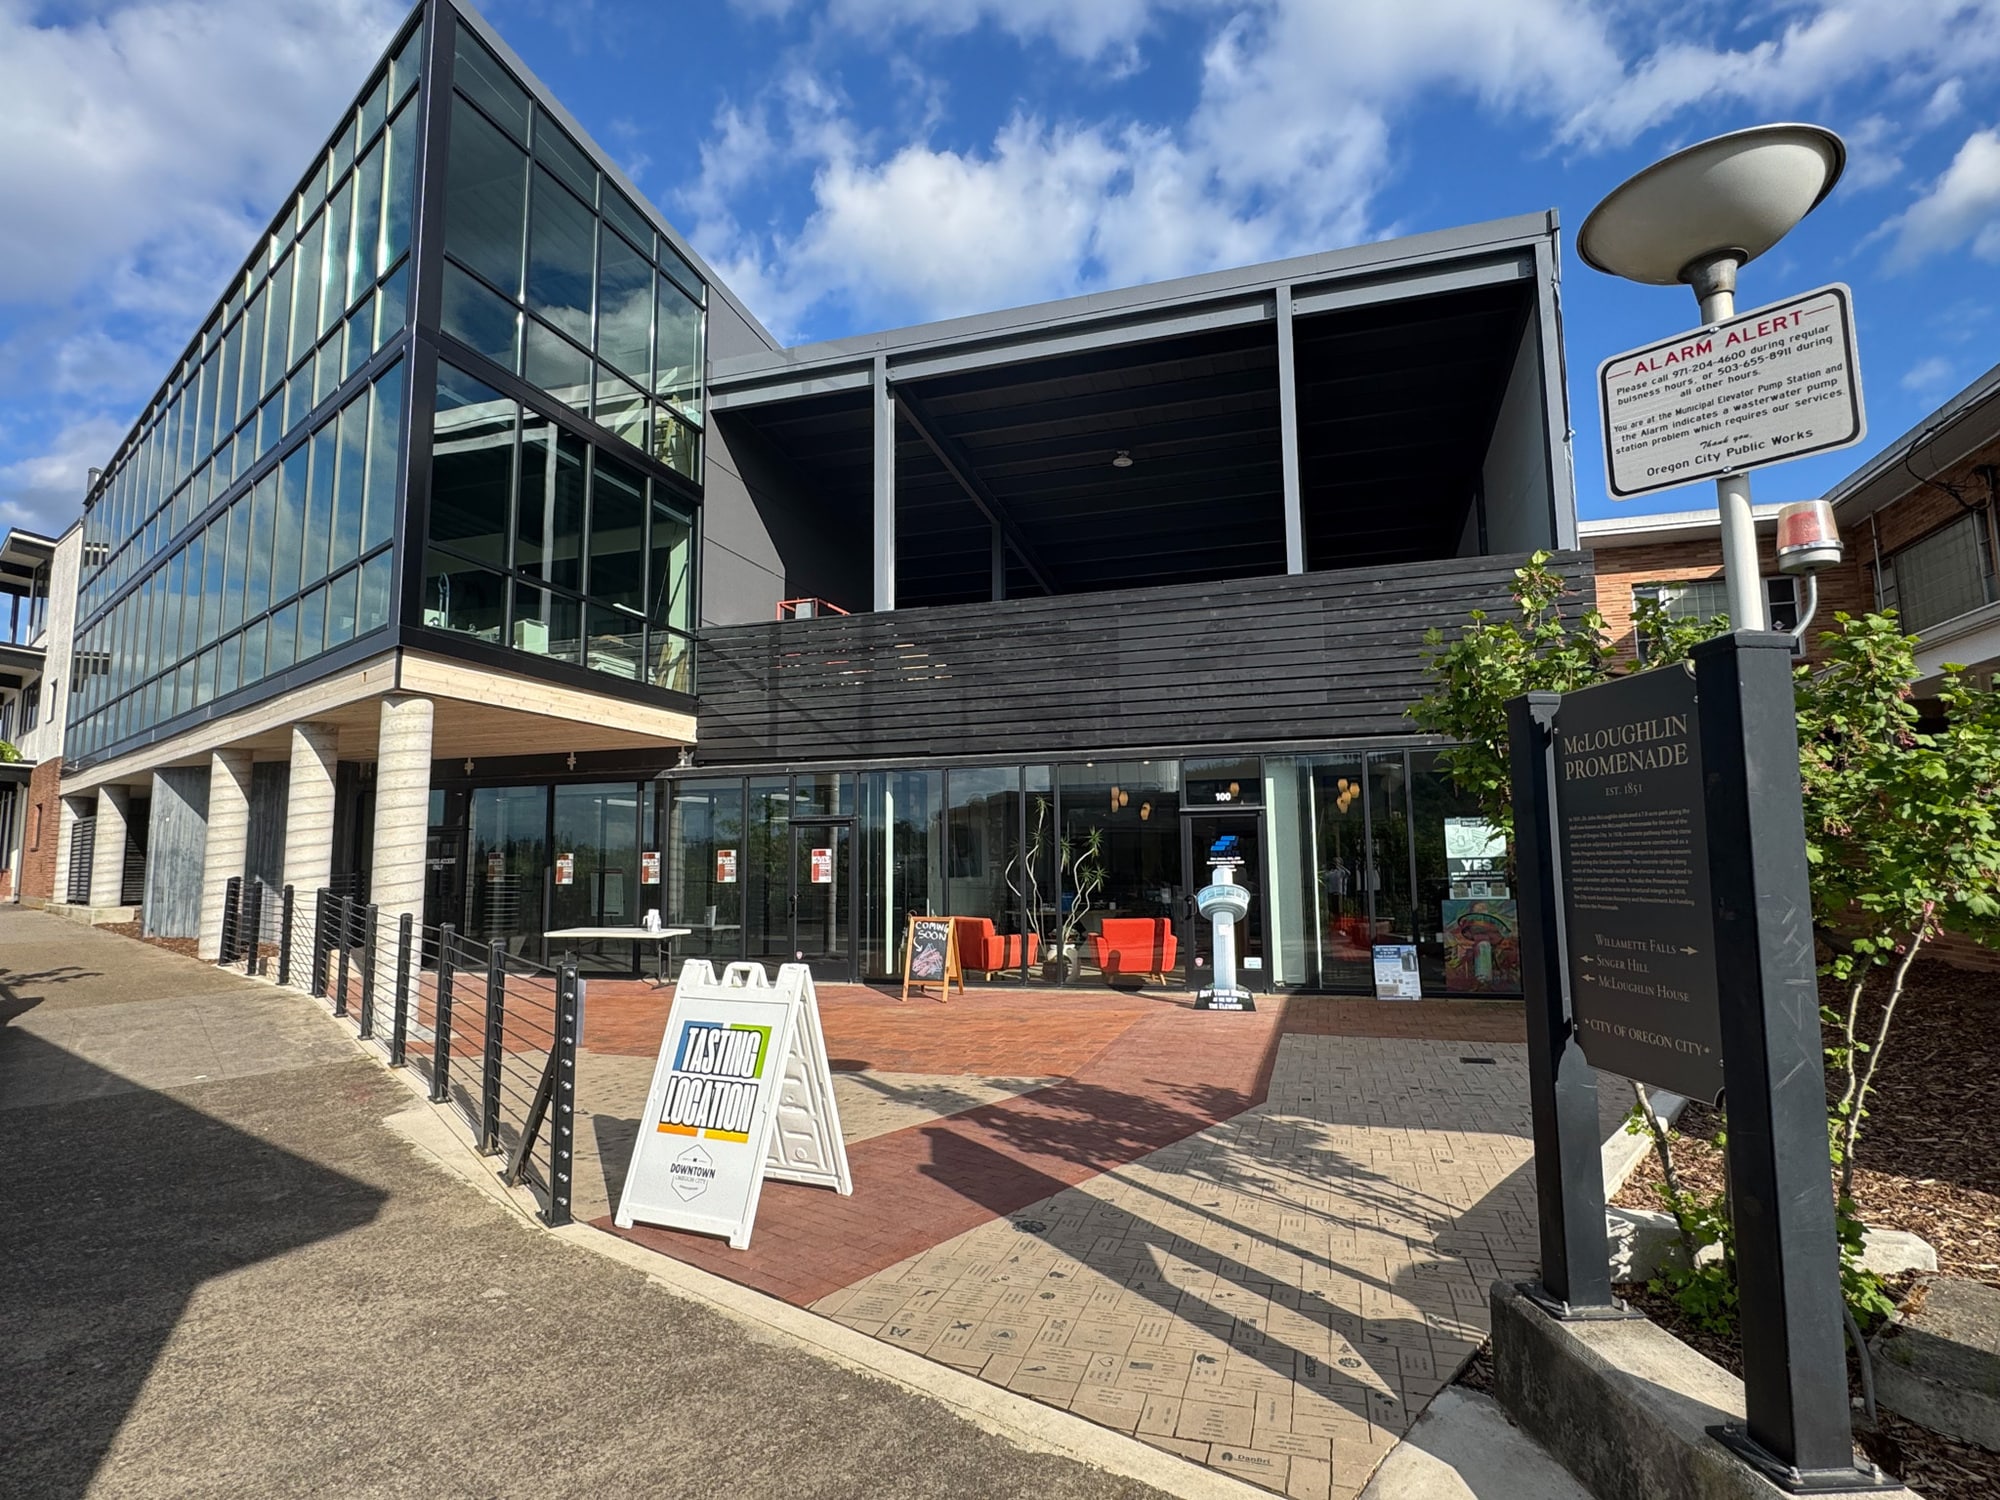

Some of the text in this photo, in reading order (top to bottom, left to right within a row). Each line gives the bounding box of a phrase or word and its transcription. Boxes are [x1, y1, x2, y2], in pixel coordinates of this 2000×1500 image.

[1616, 324, 1830, 396] Please call 971-204-4600 during regular
[1634, 310, 1803, 376] ALARM ALERT
[1617, 388, 1661, 405] buisness
[1702, 372, 1713, 381] or
[1717, 347, 1792, 376] 503-655-8911
[1796, 335, 1833, 352] during
[1680, 369, 1761, 398] all other hours.
[1614, 362, 1843, 433] You are at the Municipal Elevator Pump Station and
[1621, 433, 1637, 442] the
[1640, 424, 1668, 437] Alarm
[1672, 410, 1718, 428] indicates
[1733, 387, 1802, 411] wasterwater
[1807, 378, 1838, 393] pump
[1615, 389, 1846, 454] station problem which requires our services.
[1699, 435, 1729, 449] Thank
[1646, 429, 1814, 477] Oregon City Public Works
[1563, 713, 1688, 756] McLOUGHLIN
[1564, 743, 1689, 781] PROMENADE
[1215, 792, 1232, 801] 100
[1605, 782, 1643, 798] EST. 1851
[1460, 858, 1493, 871] YES
[917, 929, 947, 941] SOON
[680, 1027, 764, 1079] TASTING
[1590, 1019, 1703, 1056] CITY OF OREGON CITY
[661, 1076, 759, 1133] LOCATION
[670, 1163, 716, 1179] DOWNTOWN
